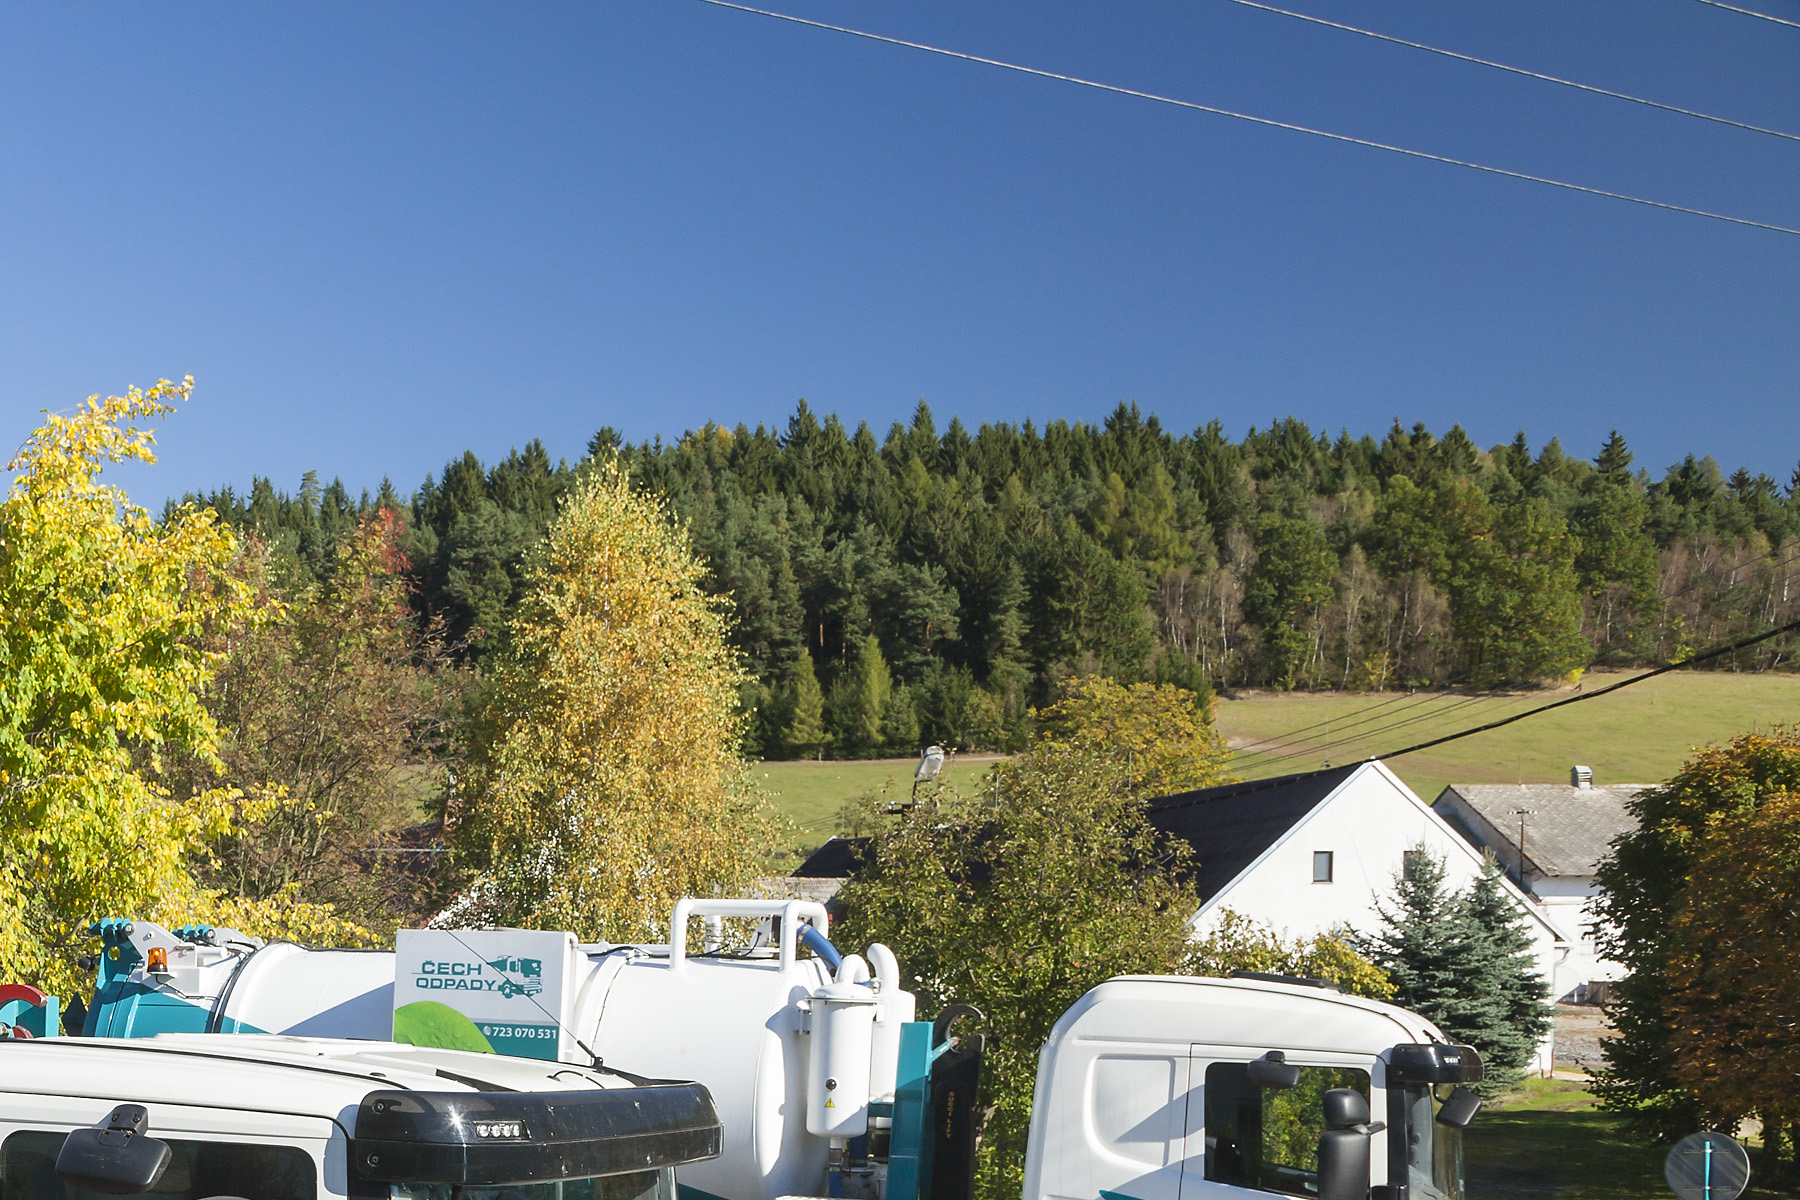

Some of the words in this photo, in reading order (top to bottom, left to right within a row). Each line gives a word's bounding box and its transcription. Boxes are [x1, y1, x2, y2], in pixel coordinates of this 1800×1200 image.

[421, 960, 482, 976] ČECH
[416, 977, 498, 991] ODPADY
[492, 1026, 513, 1038] 723
[515, 1027, 535, 1038] 070
[538, 1028, 557, 1039] 531
